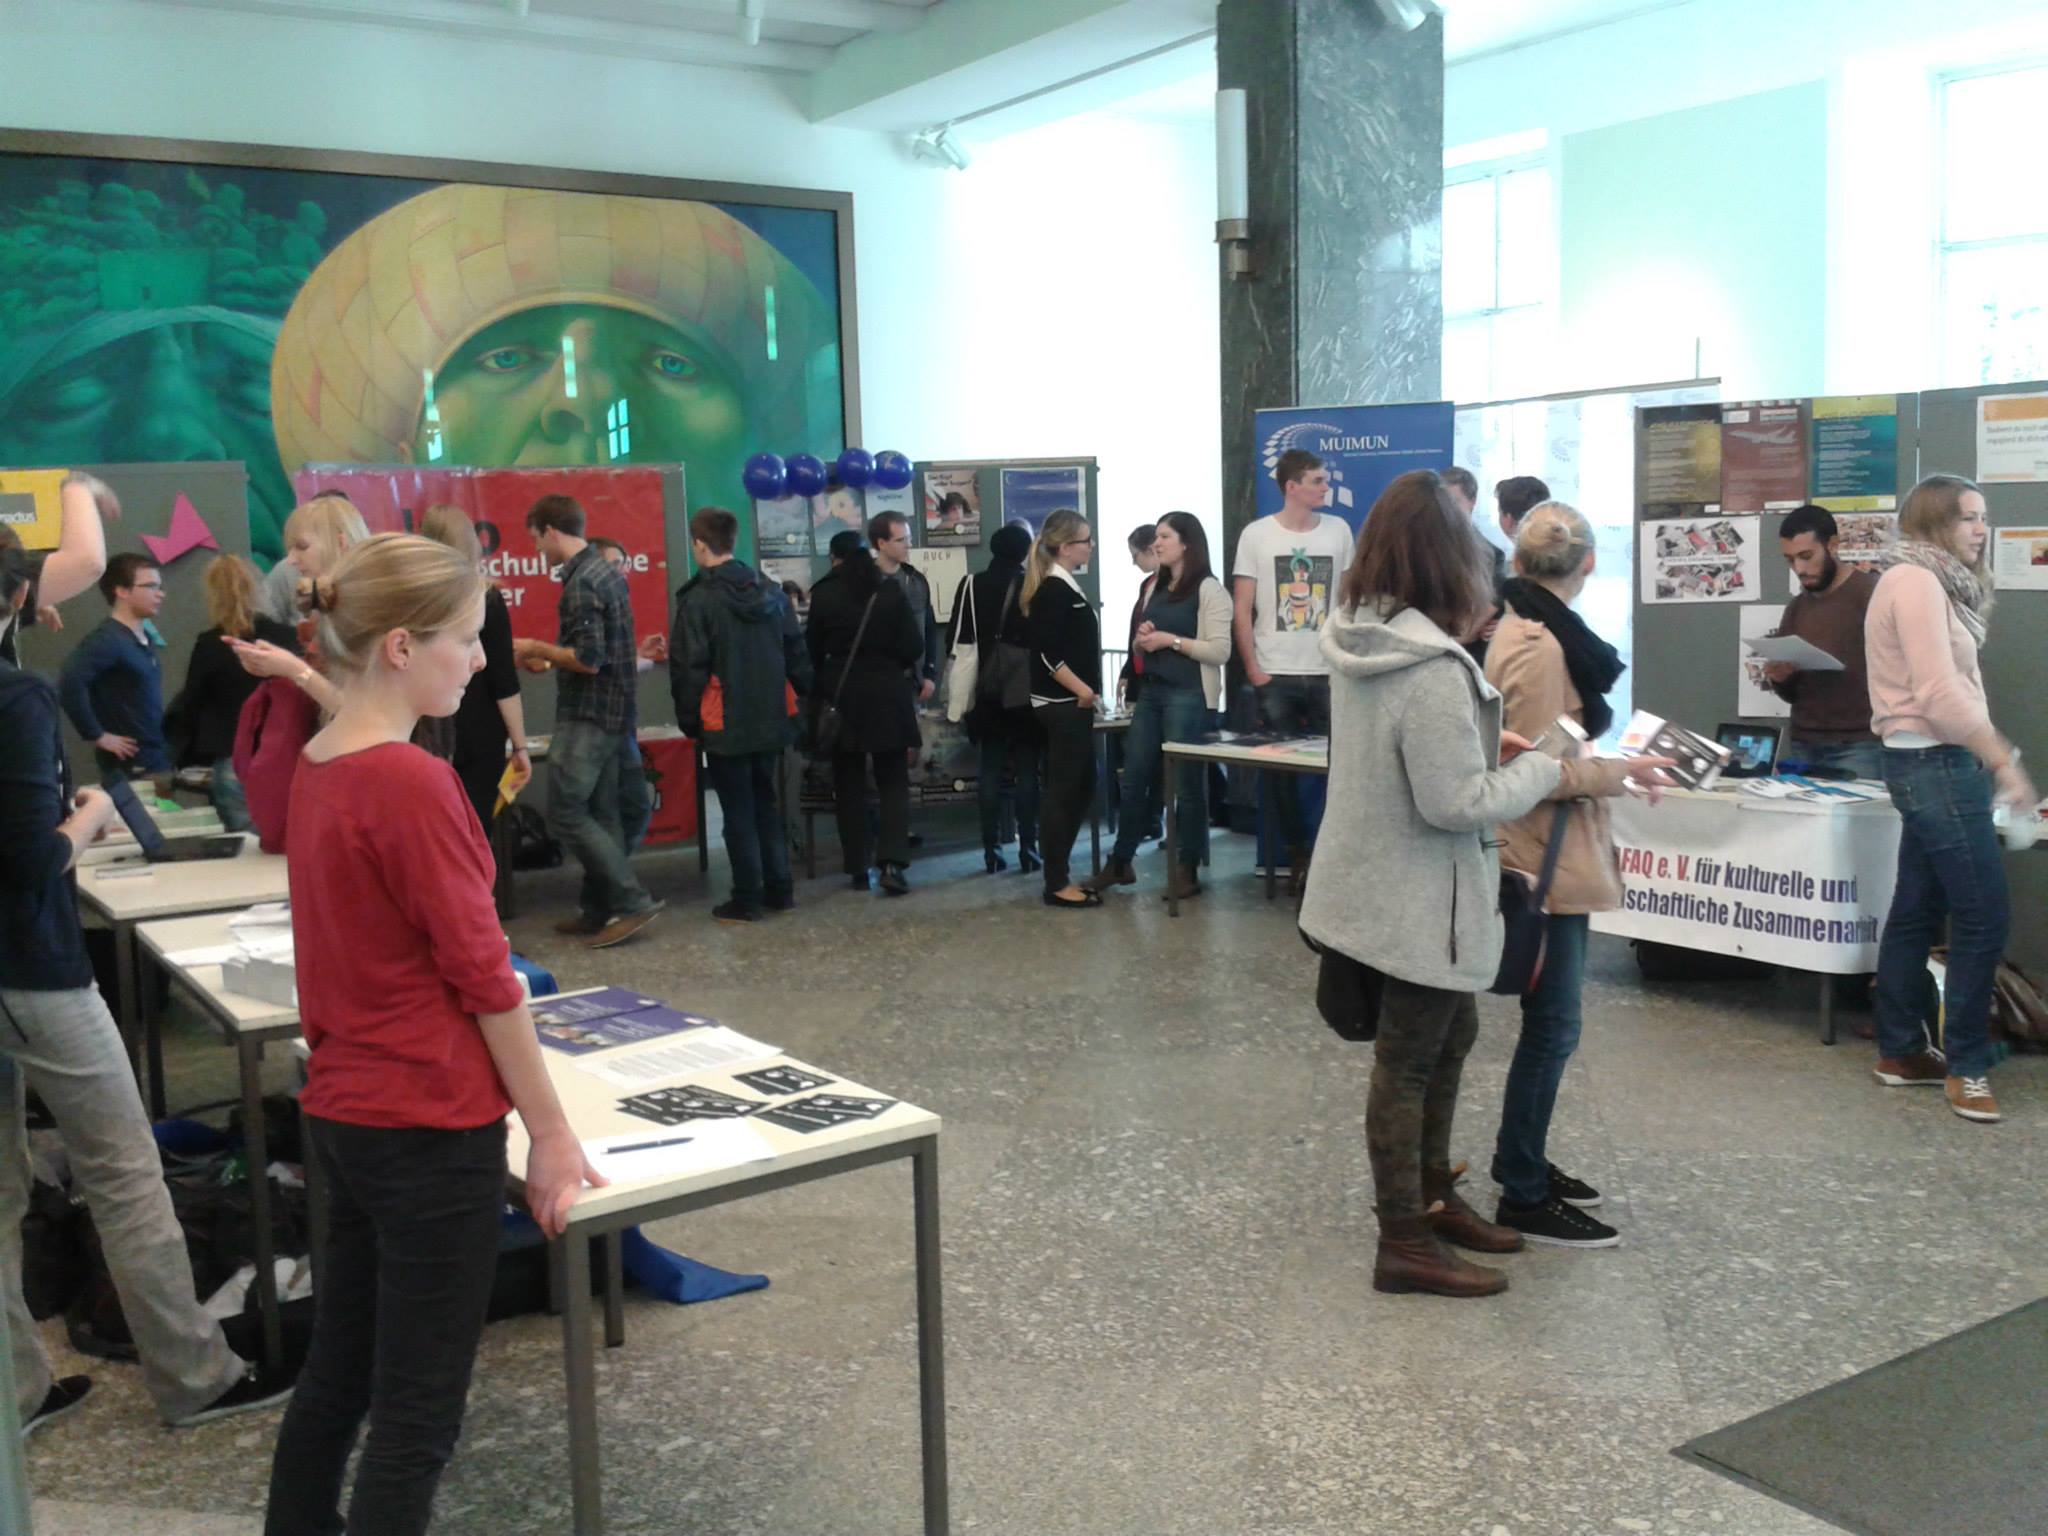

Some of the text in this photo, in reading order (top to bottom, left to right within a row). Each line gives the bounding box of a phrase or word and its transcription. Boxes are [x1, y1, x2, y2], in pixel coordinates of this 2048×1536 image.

[1319, 435, 1389, 451] MUIMUN
[1657, 856, 1671, 879] e.
[1677, 854, 1690, 882] V.
[1694, 856, 1722, 887] für
[1723, 861, 1815, 901] kulturelle
[1820, 874, 1858, 904] und
[1620, 883, 1729, 927] schaftliche
